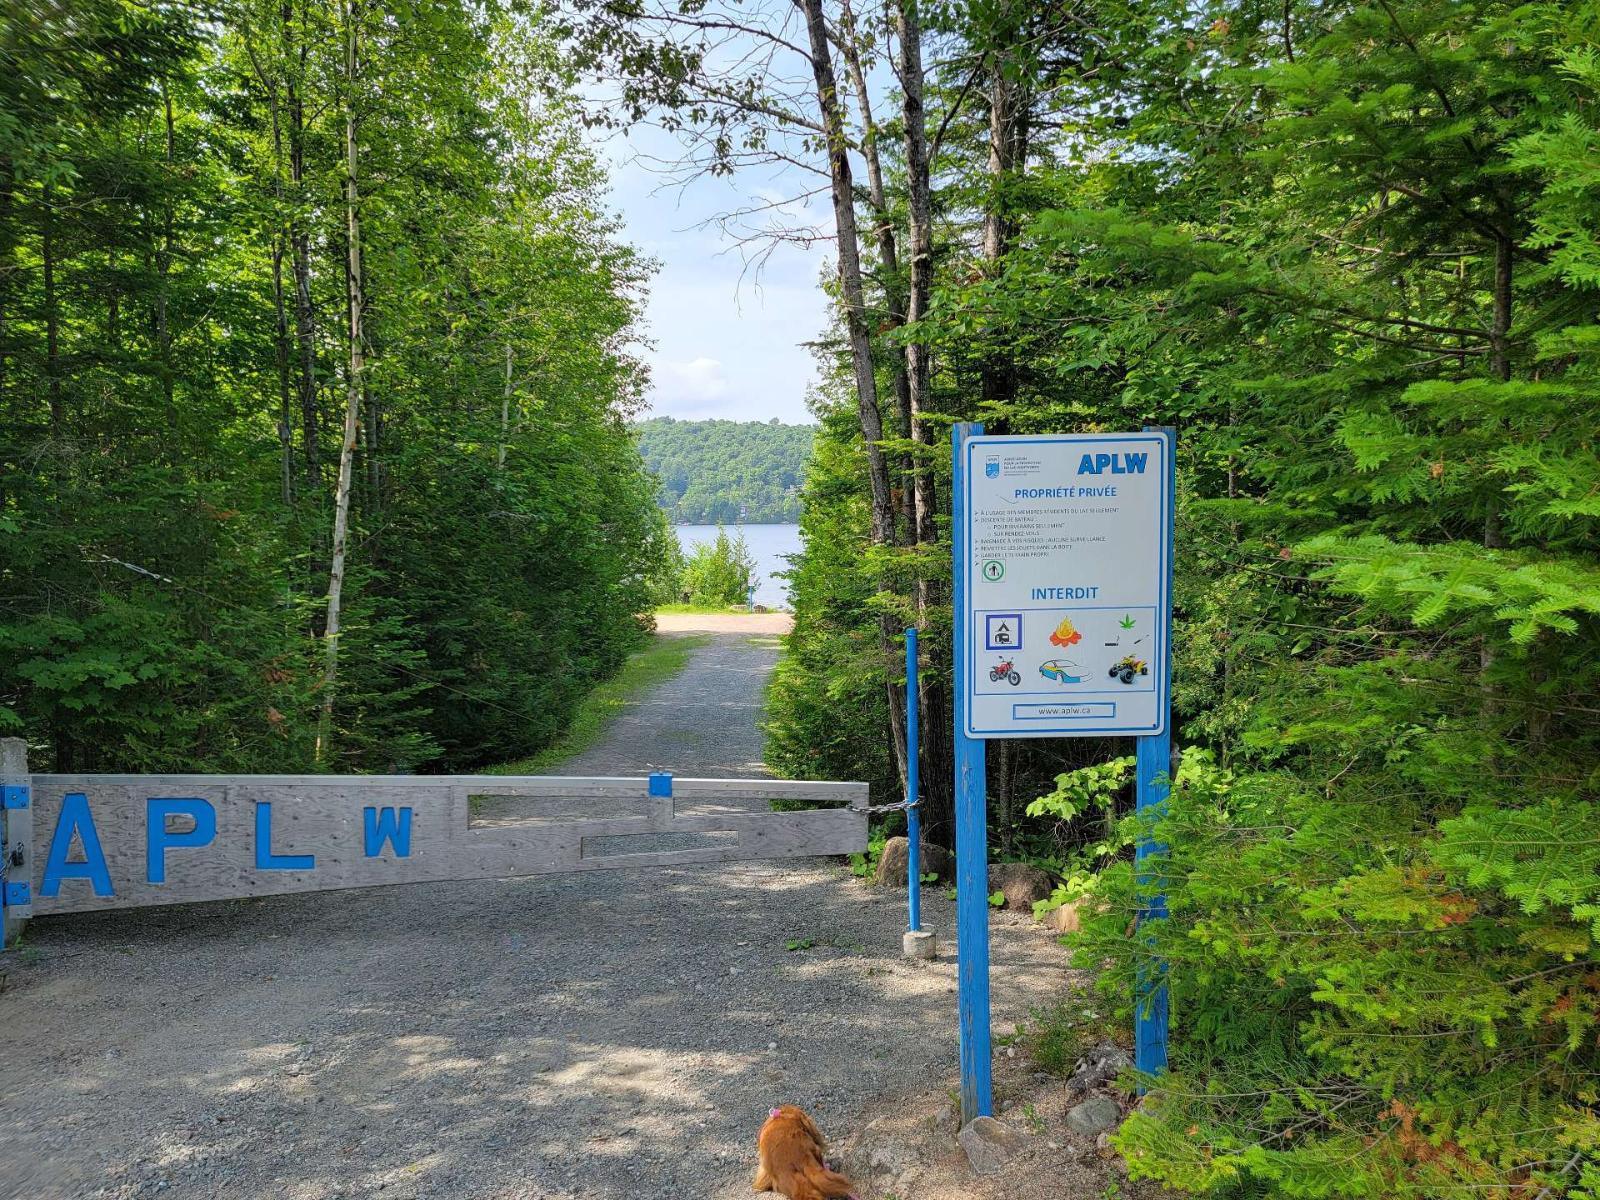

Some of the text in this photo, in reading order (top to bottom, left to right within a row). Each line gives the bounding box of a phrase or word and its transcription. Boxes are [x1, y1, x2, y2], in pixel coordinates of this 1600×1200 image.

[1077, 453, 1148, 475] APLW
[1014, 484, 1117, 499] PROPRIÉTÉ PRIVÉE
[1031, 586, 1099, 600] INTERDIT
[1039, 706, 1091, 715] www.aplw.ca
